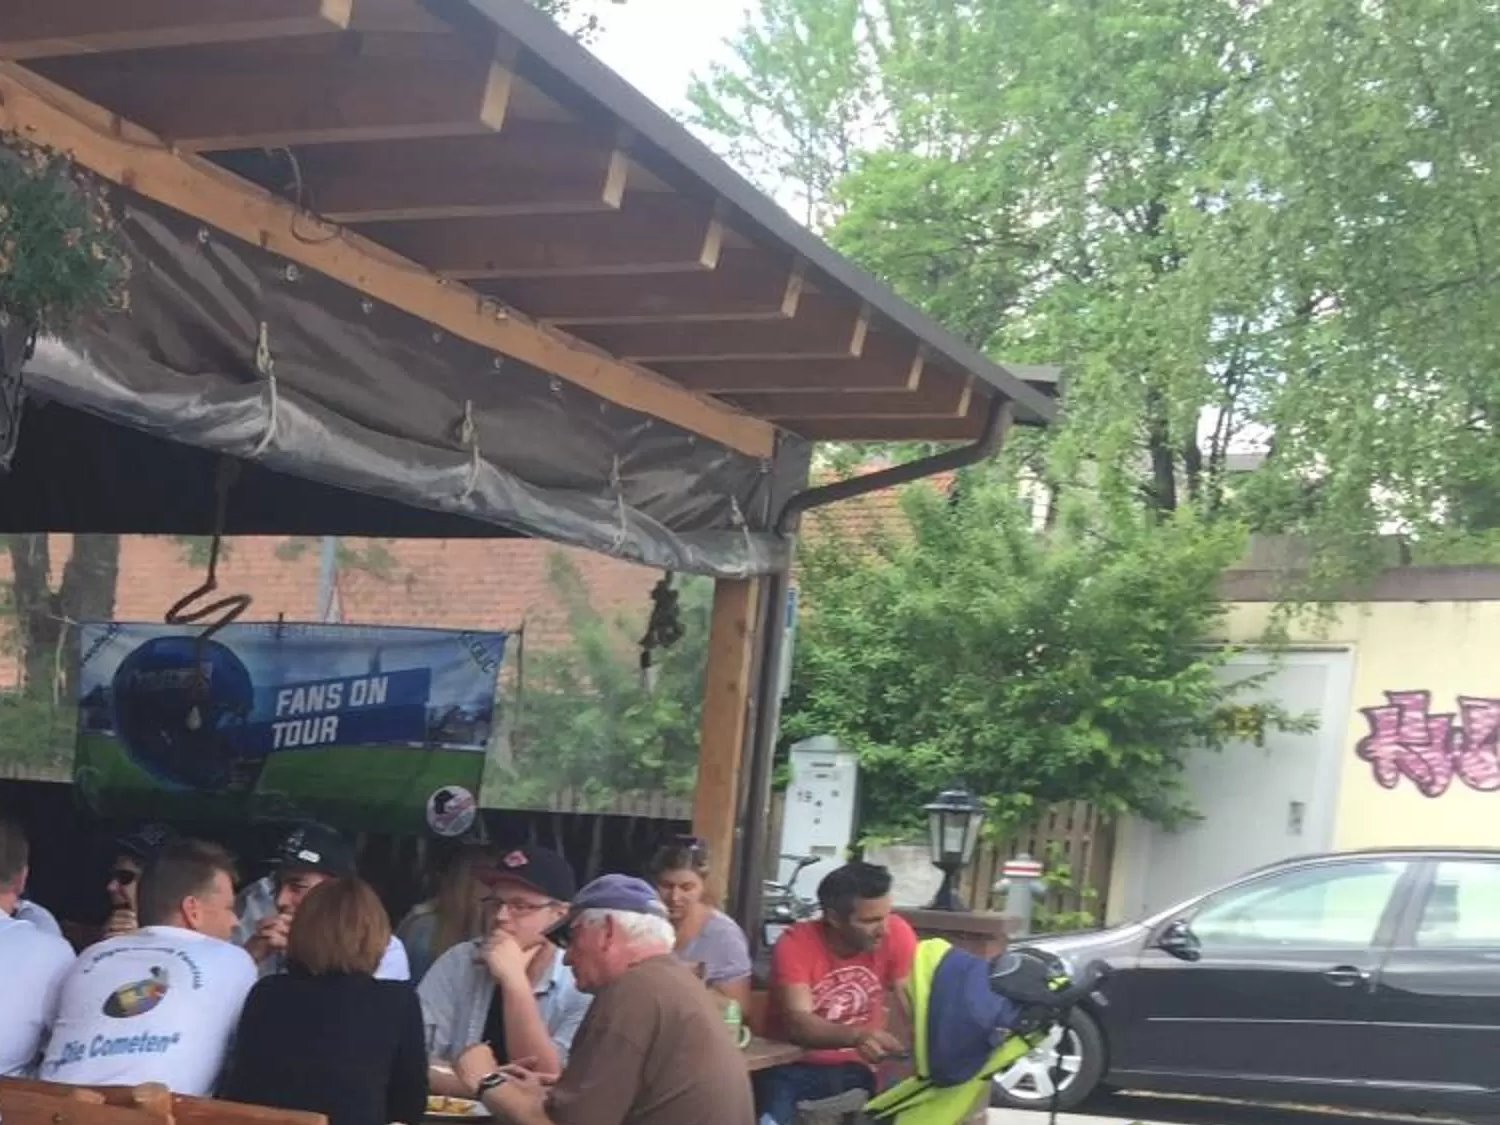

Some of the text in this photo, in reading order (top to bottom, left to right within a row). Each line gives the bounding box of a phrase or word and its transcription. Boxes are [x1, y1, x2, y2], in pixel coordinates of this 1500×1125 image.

[275, 676, 389, 716] FANS ON
[272, 715, 339, 750] TOUR
